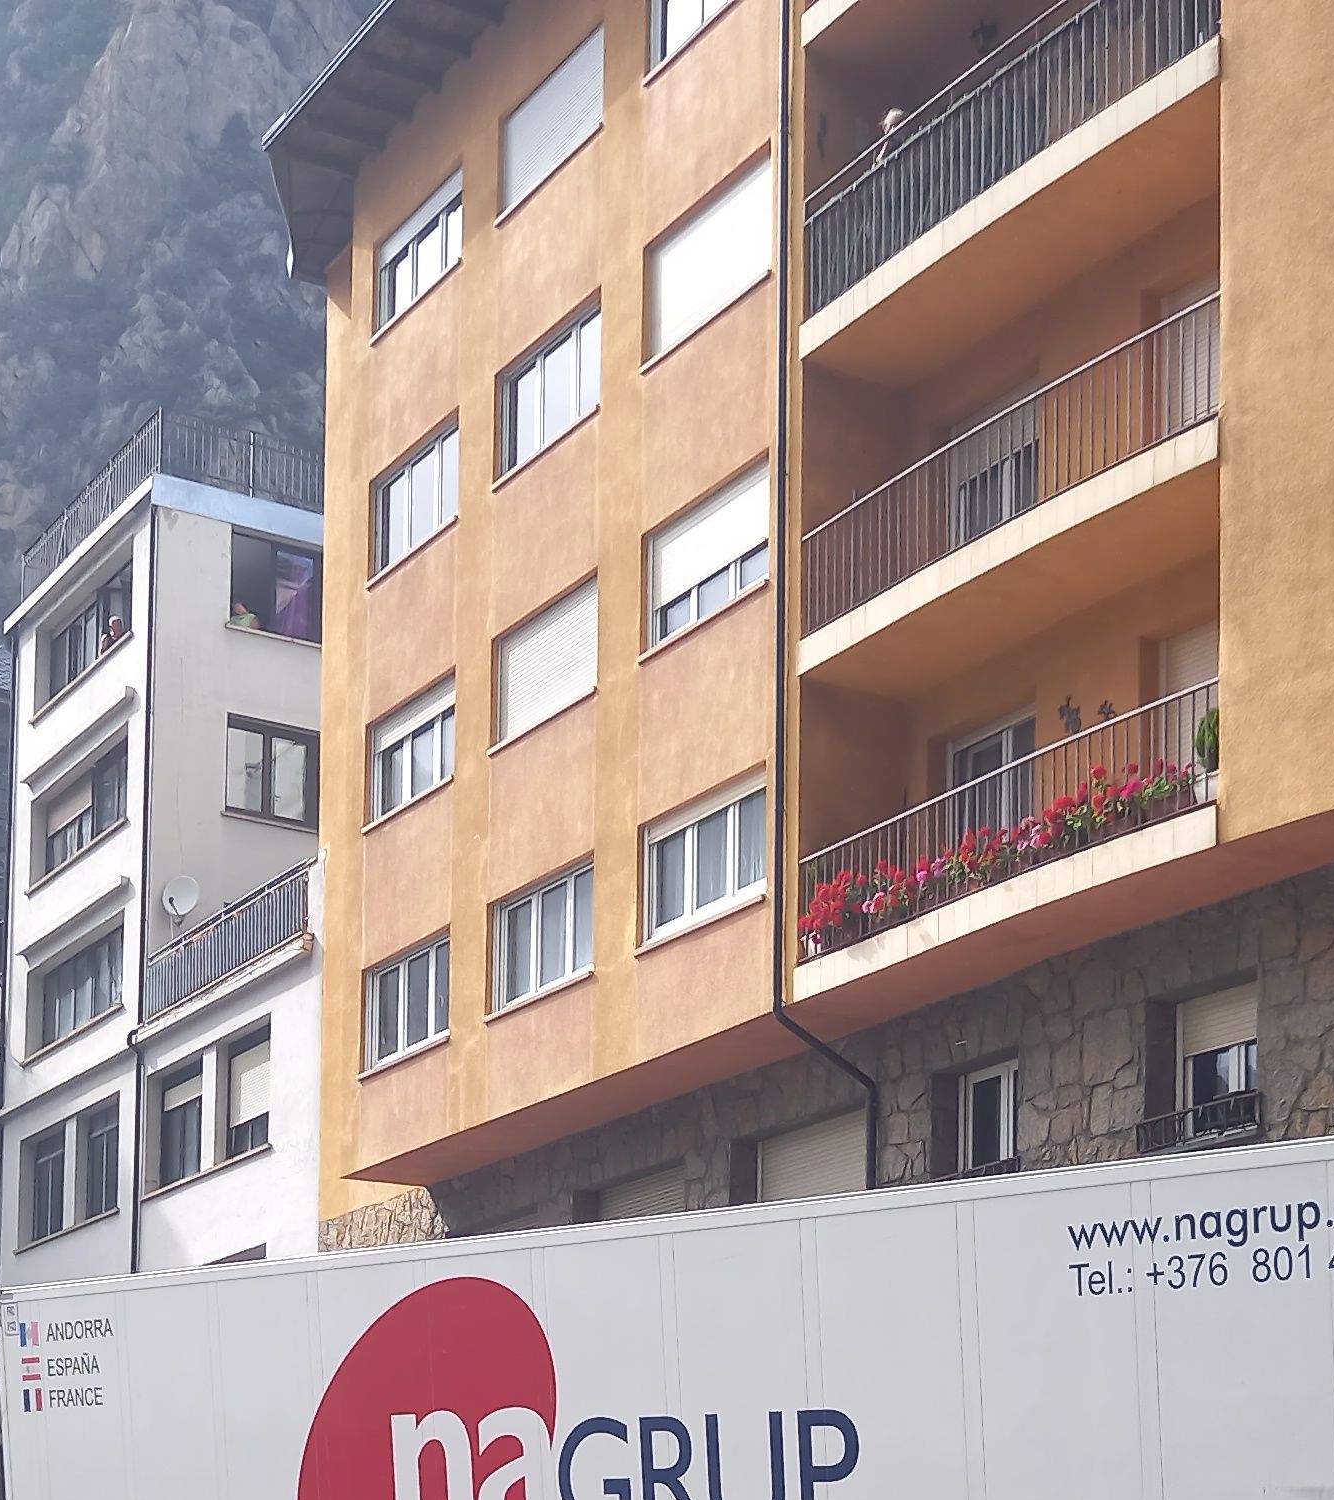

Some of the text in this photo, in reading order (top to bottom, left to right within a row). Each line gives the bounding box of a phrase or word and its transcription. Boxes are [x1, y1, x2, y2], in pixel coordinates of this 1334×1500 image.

[1069, 1261, 1133, 1297] Tel.:
[1146, 1251, 1228, 1290] +376
[1252, 1244, 1312, 1283] 801
[46, 1318, 114, 1342] ANDORRA
[47, 1353, 101, 1377] ESPAÑA
[49, 1387, 104, 1408] FRANCE
